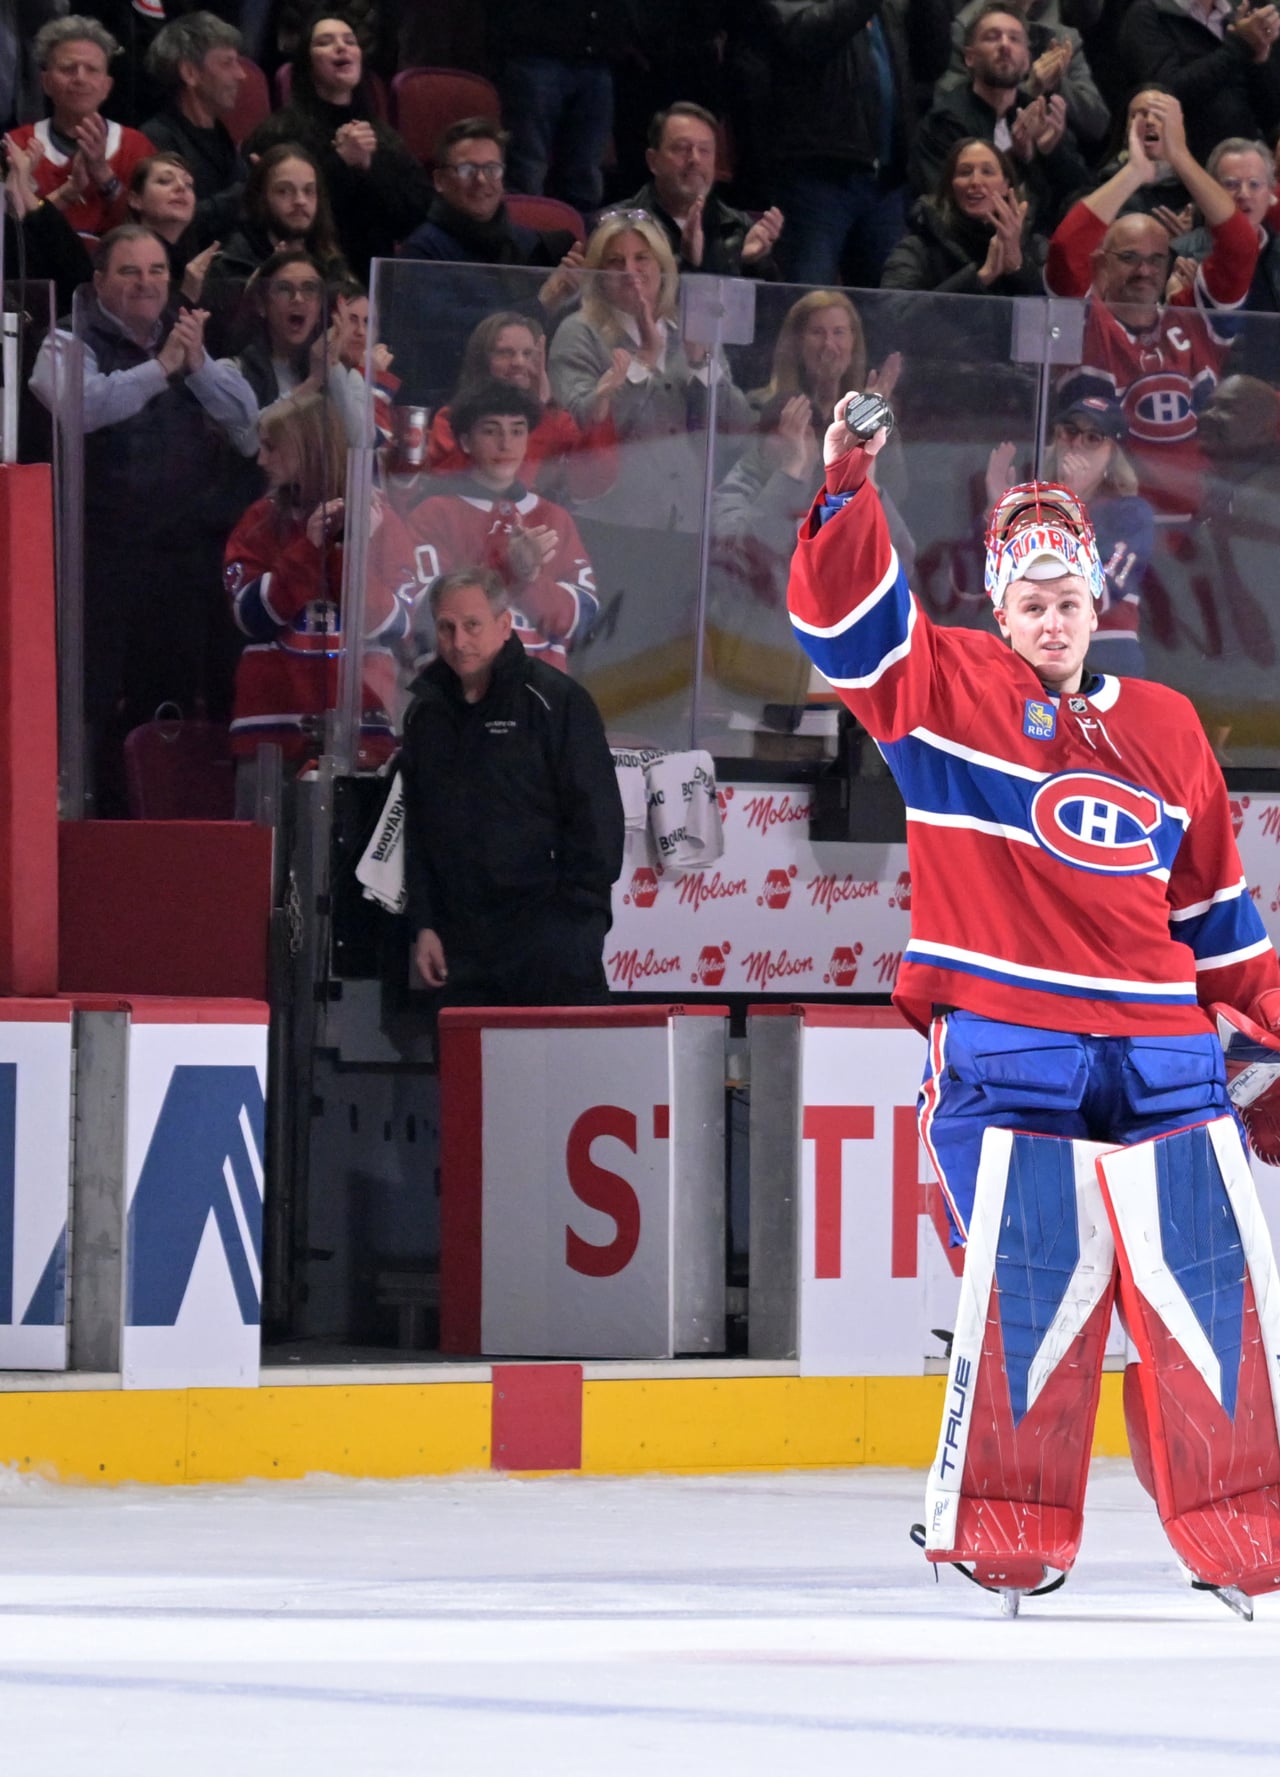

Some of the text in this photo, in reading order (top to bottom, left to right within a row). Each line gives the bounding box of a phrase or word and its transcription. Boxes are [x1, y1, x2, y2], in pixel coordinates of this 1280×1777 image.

[1166, 326, 1191, 351] C
[1028, 725, 1051, 737] RBC
[743, 796, 814, 835] Molson
[675, 872, 747, 913] Molson
[807, 874, 878, 914] Molson
[608, 949, 680, 989] Molson
[741, 950, 813, 990] Molson
[565, 1104, 670, 1278] S
[941, 1356, 971, 1480] TRUE
